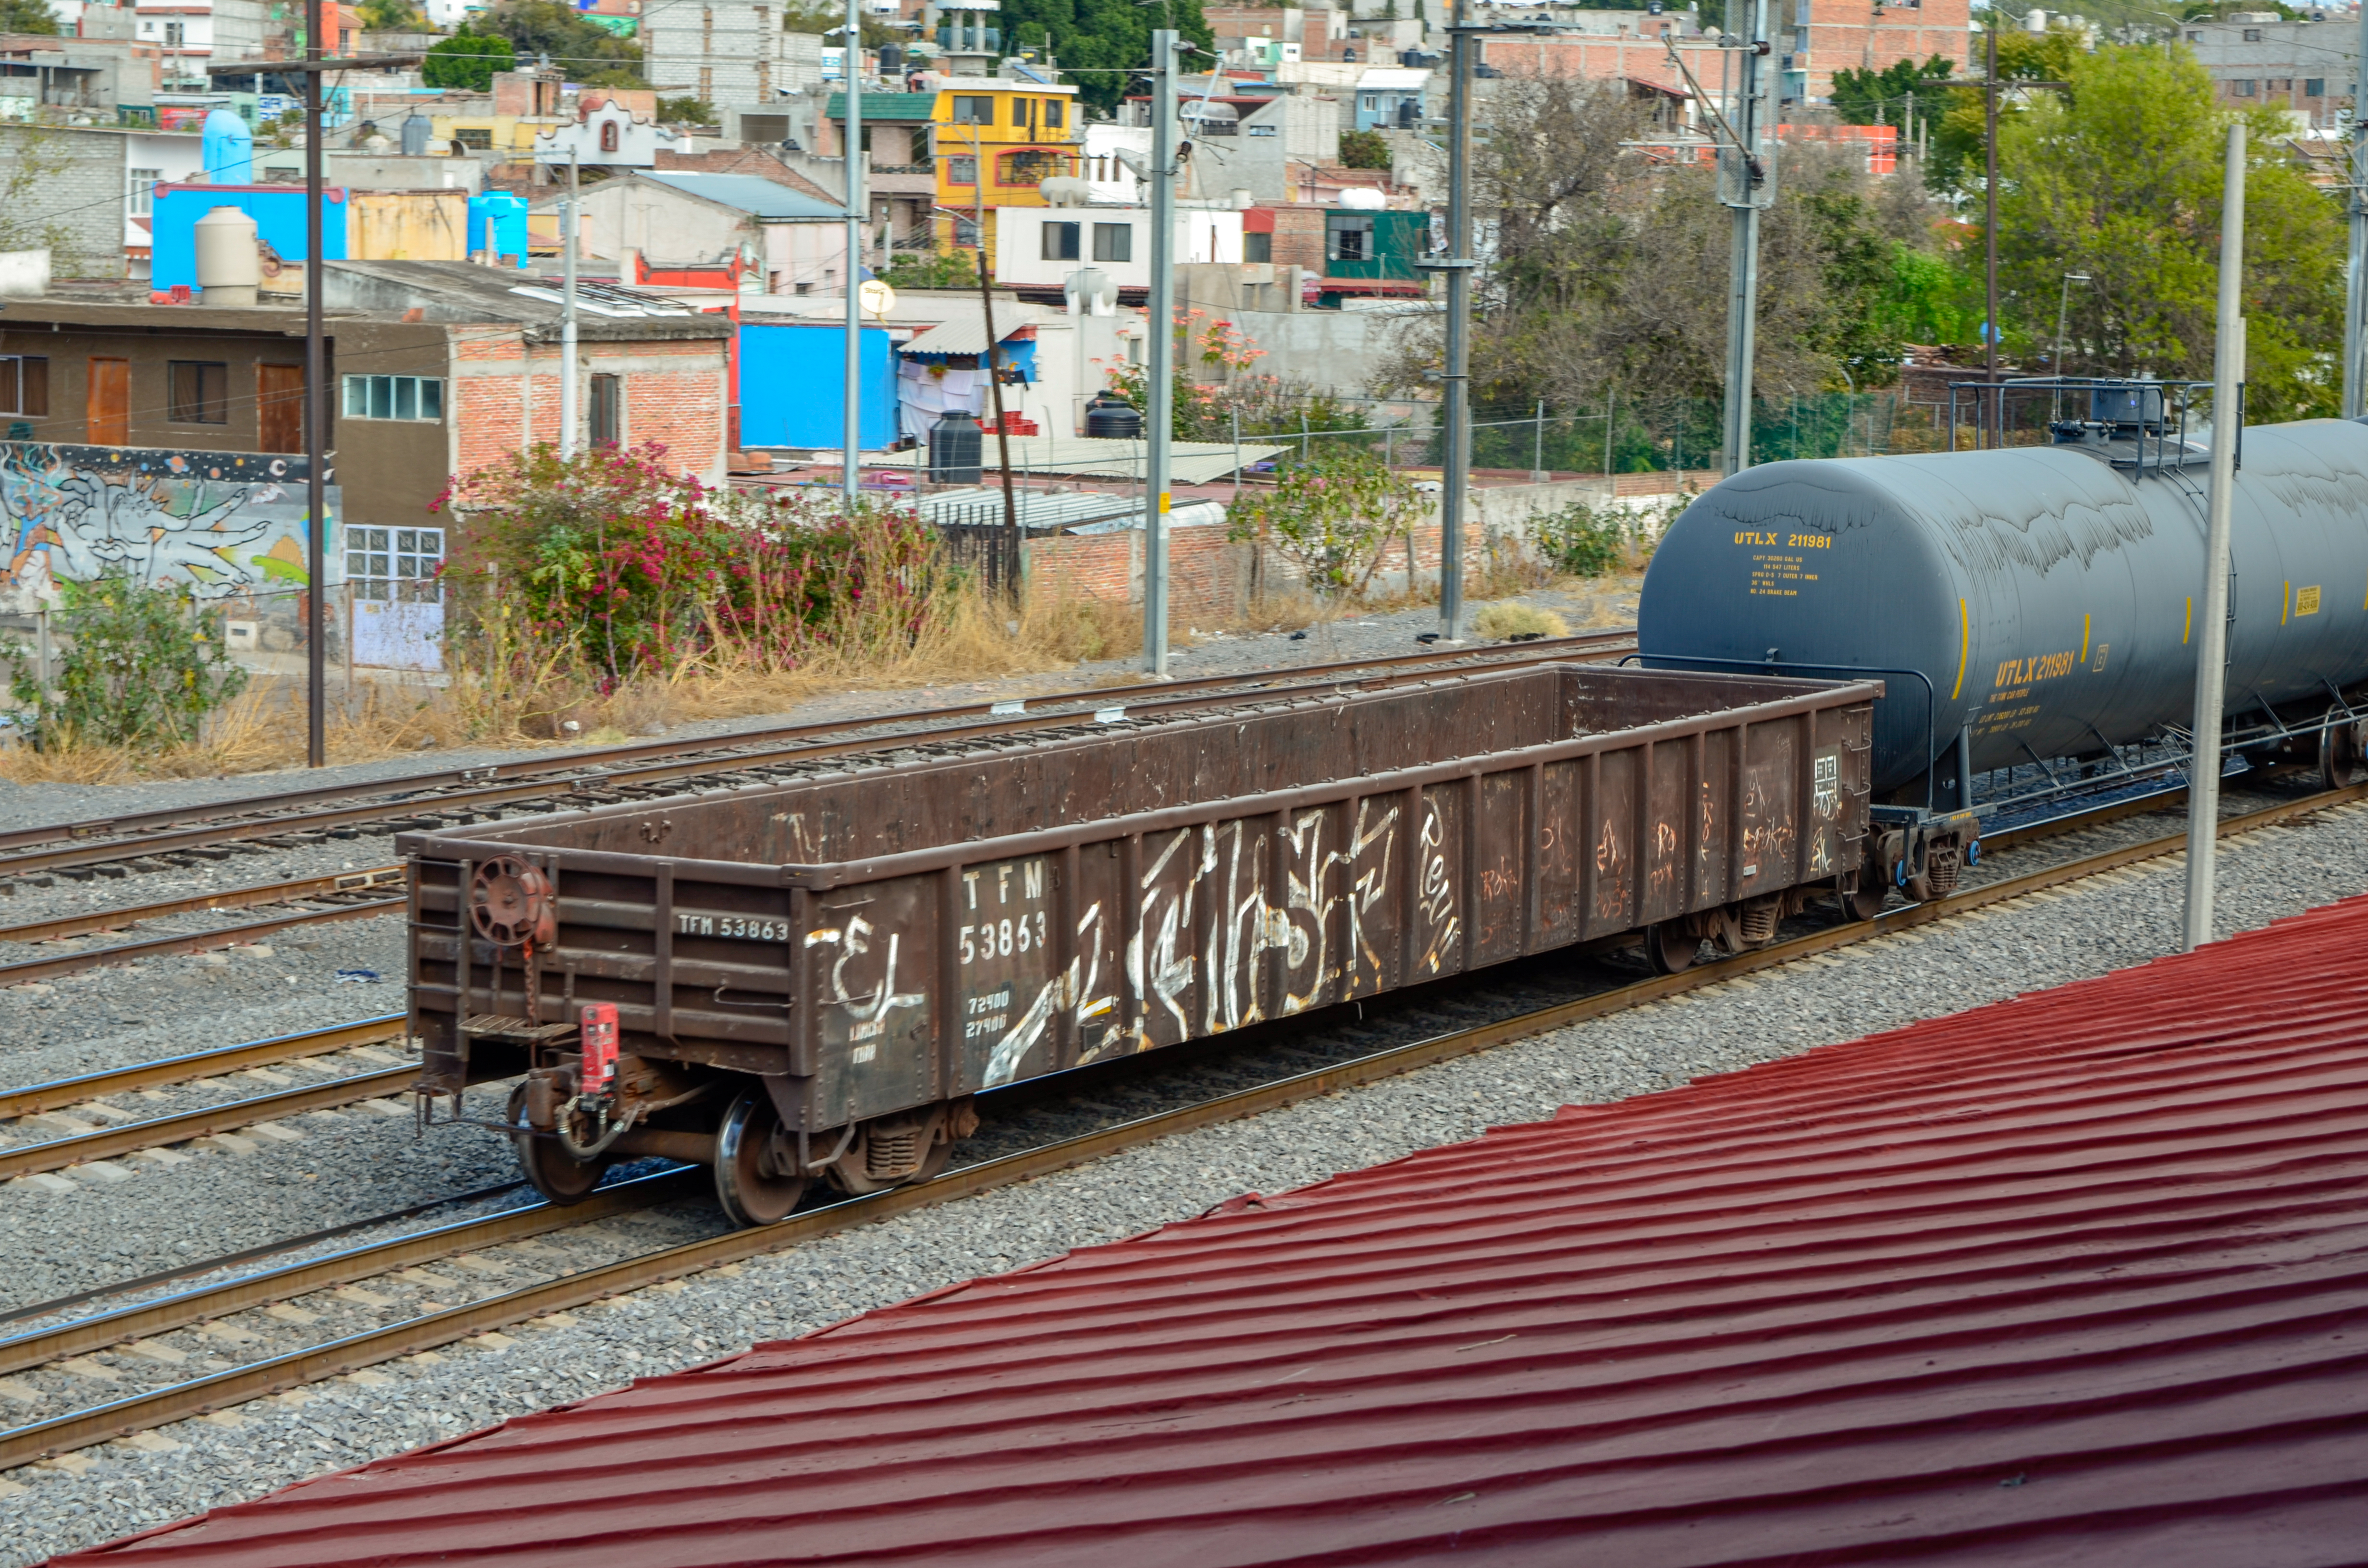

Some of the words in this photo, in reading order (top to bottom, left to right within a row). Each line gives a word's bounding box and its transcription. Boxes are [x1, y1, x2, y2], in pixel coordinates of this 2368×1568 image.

[1734, 532, 1778, 545] UTLX
[1788, 534, 1831, 549] 211981
[1996, 657, 2038, 687] UTLX
[2035, 650, 2074, 680] 211981
[962, 860, 1042, 909] TFM
[678, 914, 713, 935] TFM
[720, 918, 789, 941] 53863
[960, 911, 1046, 965] 53863
[968, 990, 1010, 1015] 72400
[965, 1013, 1007, 1038] 27400
